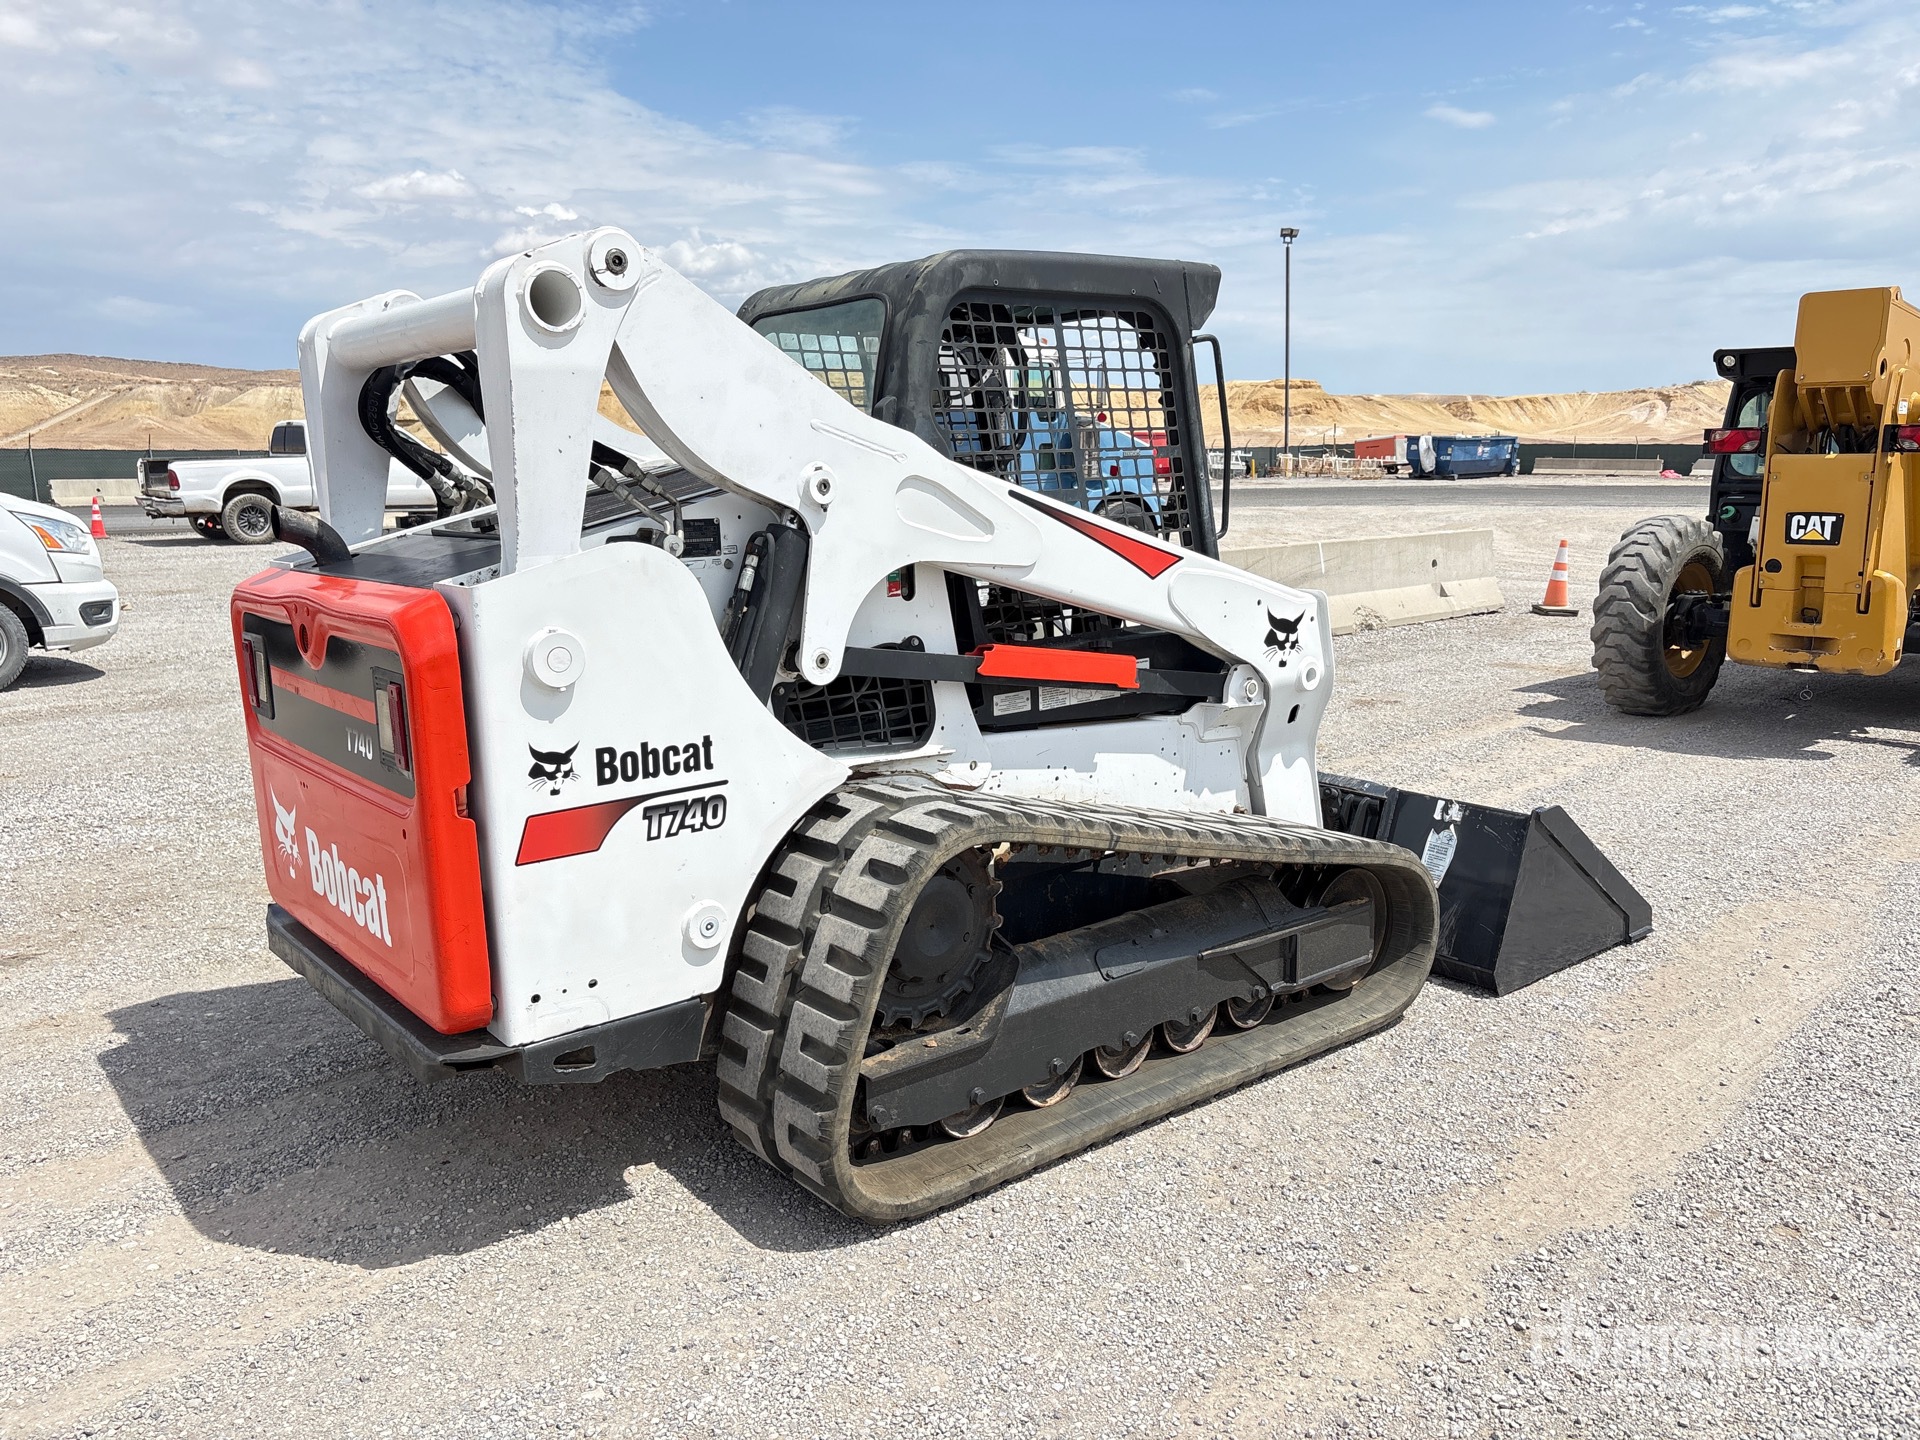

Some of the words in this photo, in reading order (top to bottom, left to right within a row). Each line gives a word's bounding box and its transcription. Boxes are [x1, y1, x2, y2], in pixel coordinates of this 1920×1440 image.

[1790, 514, 1837, 541] CAT
[345, 726, 373, 760] T740
[595, 735, 714, 787] Bobcat
[642, 794, 727, 841] T740
[305, 826, 392, 948] Bobcat
